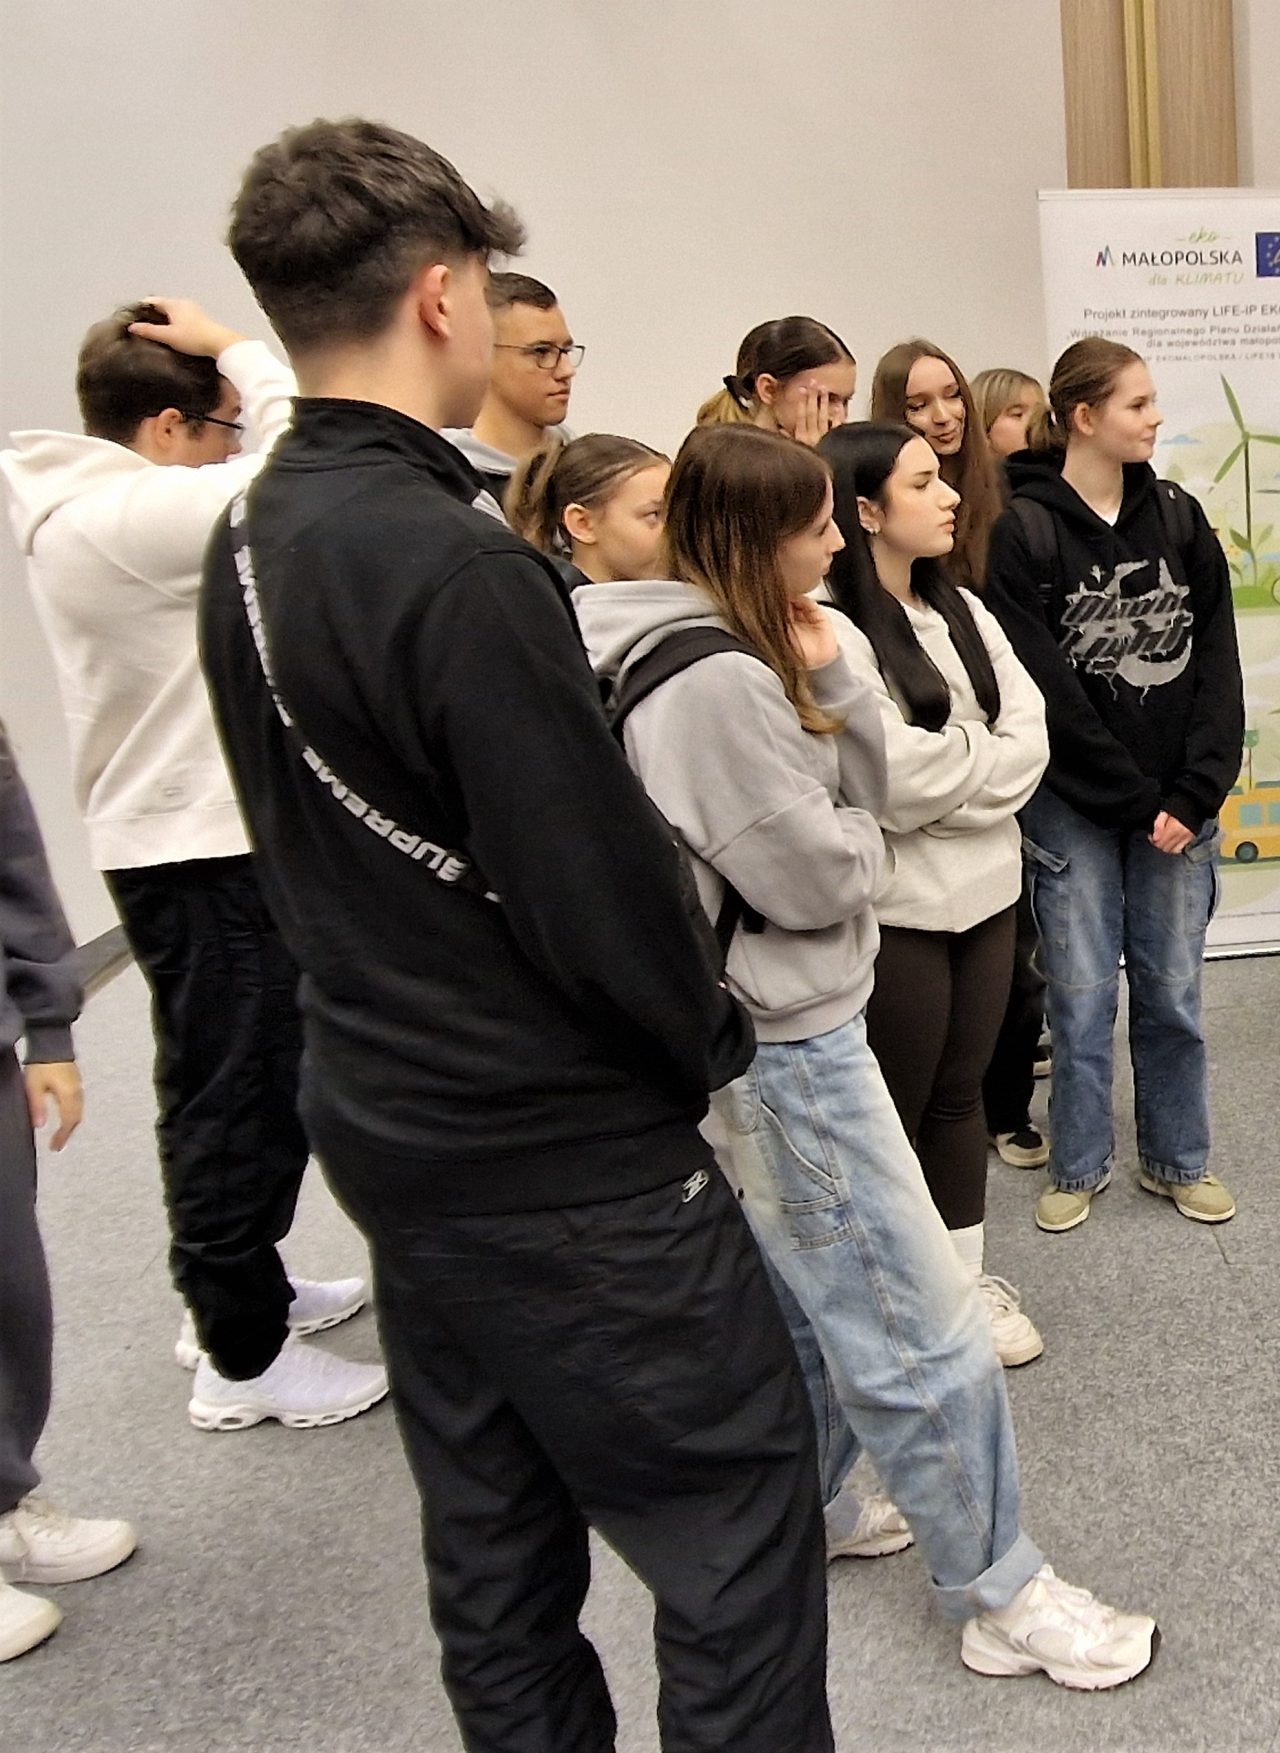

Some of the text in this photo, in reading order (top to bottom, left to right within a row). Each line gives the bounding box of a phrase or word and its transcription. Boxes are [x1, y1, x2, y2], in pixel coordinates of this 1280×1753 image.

[1122, 250, 1243, 267] MAŁOPOLSKA
[1175, 272, 1244, 285] KLIMATU
[1083, 308, 1126, 322] Projekt
[1130, 307, 1209, 320] zintegrowany
[1212, 304, 1257, 317] LIFE-IP
[1132, 326, 1206, 338] Regionalnego
[1209, 325, 1240, 335] Planu
[1145, 339, 1163, 349] dla
